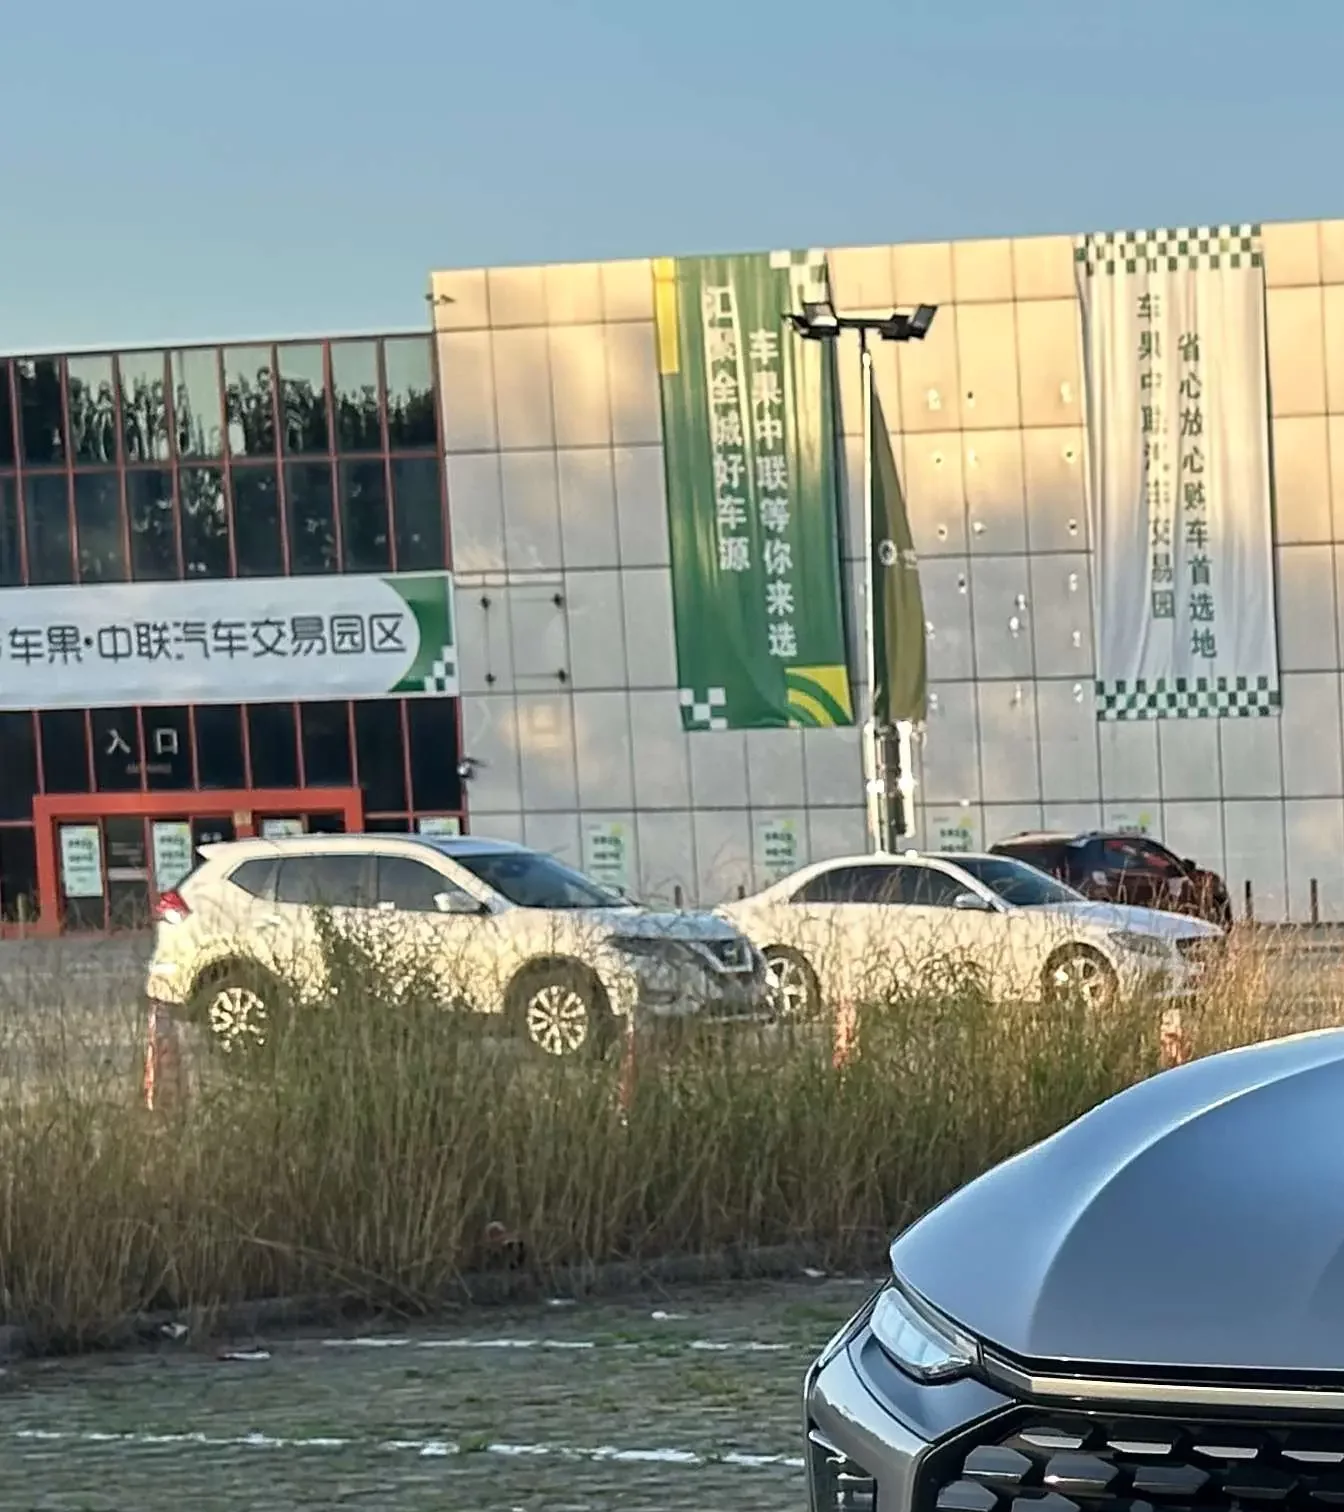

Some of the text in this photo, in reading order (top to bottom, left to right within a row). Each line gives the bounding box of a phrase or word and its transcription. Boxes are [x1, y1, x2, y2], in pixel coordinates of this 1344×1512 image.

[703, 286, 750, 571] 汇全城好车源
[749, 328, 797, 657] 车果中联等你来选
[8, 613, 407, 666] 车果·中联汽车交易园区
[106, 728, 179, 755] 入口
